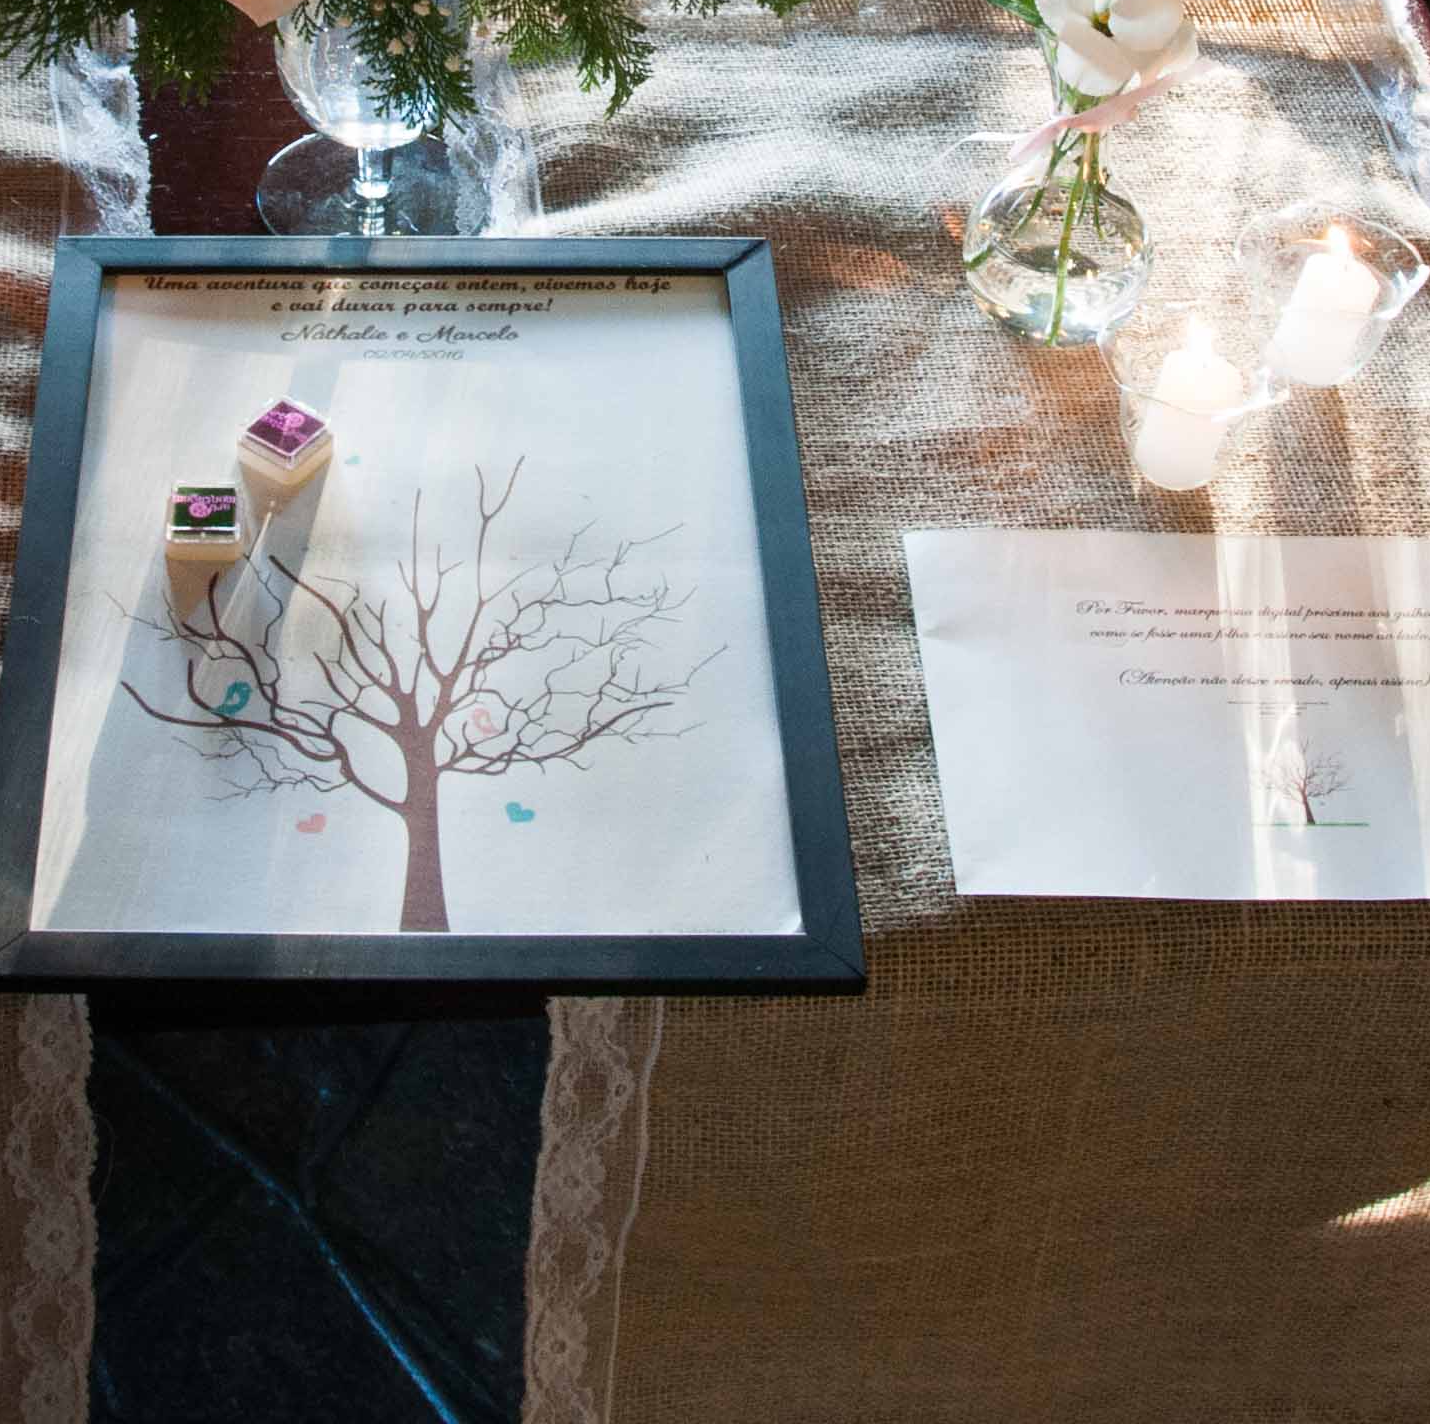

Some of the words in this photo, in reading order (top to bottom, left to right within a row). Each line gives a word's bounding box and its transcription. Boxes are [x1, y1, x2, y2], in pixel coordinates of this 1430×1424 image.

[144, 276, 198, 290] Uma
[206, 278, 306, 290] aventura
[312, 278, 352, 294] que
[359, 279, 449, 294] começou
[456, 278, 527, 293] ontem,
[534, 278, 616, 290] vivemos
[625, 276, 672, 294] hoje
[270, 302, 284, 312] e
[289, 300, 324, 312] vai
[332, 298, 396, 312] durar
[404, 300, 459, 315] para
[466, 298, 554, 315] sempre!
[281, 324, 388, 342] Nathalie
[396, 331, 408, 340] e
[416, 324, 518, 343] Marcelo
[1076, 600, 1111, 615] Por
[1259, 605, 1304, 622] digital
[1089, 630, 1126, 639] como
[1146, 627, 1177, 641] fosse
[1180, 632, 1213, 640] uma
[1335, 632, 1374, 640] nome
[1328, 676, 1378, 691] apenas
